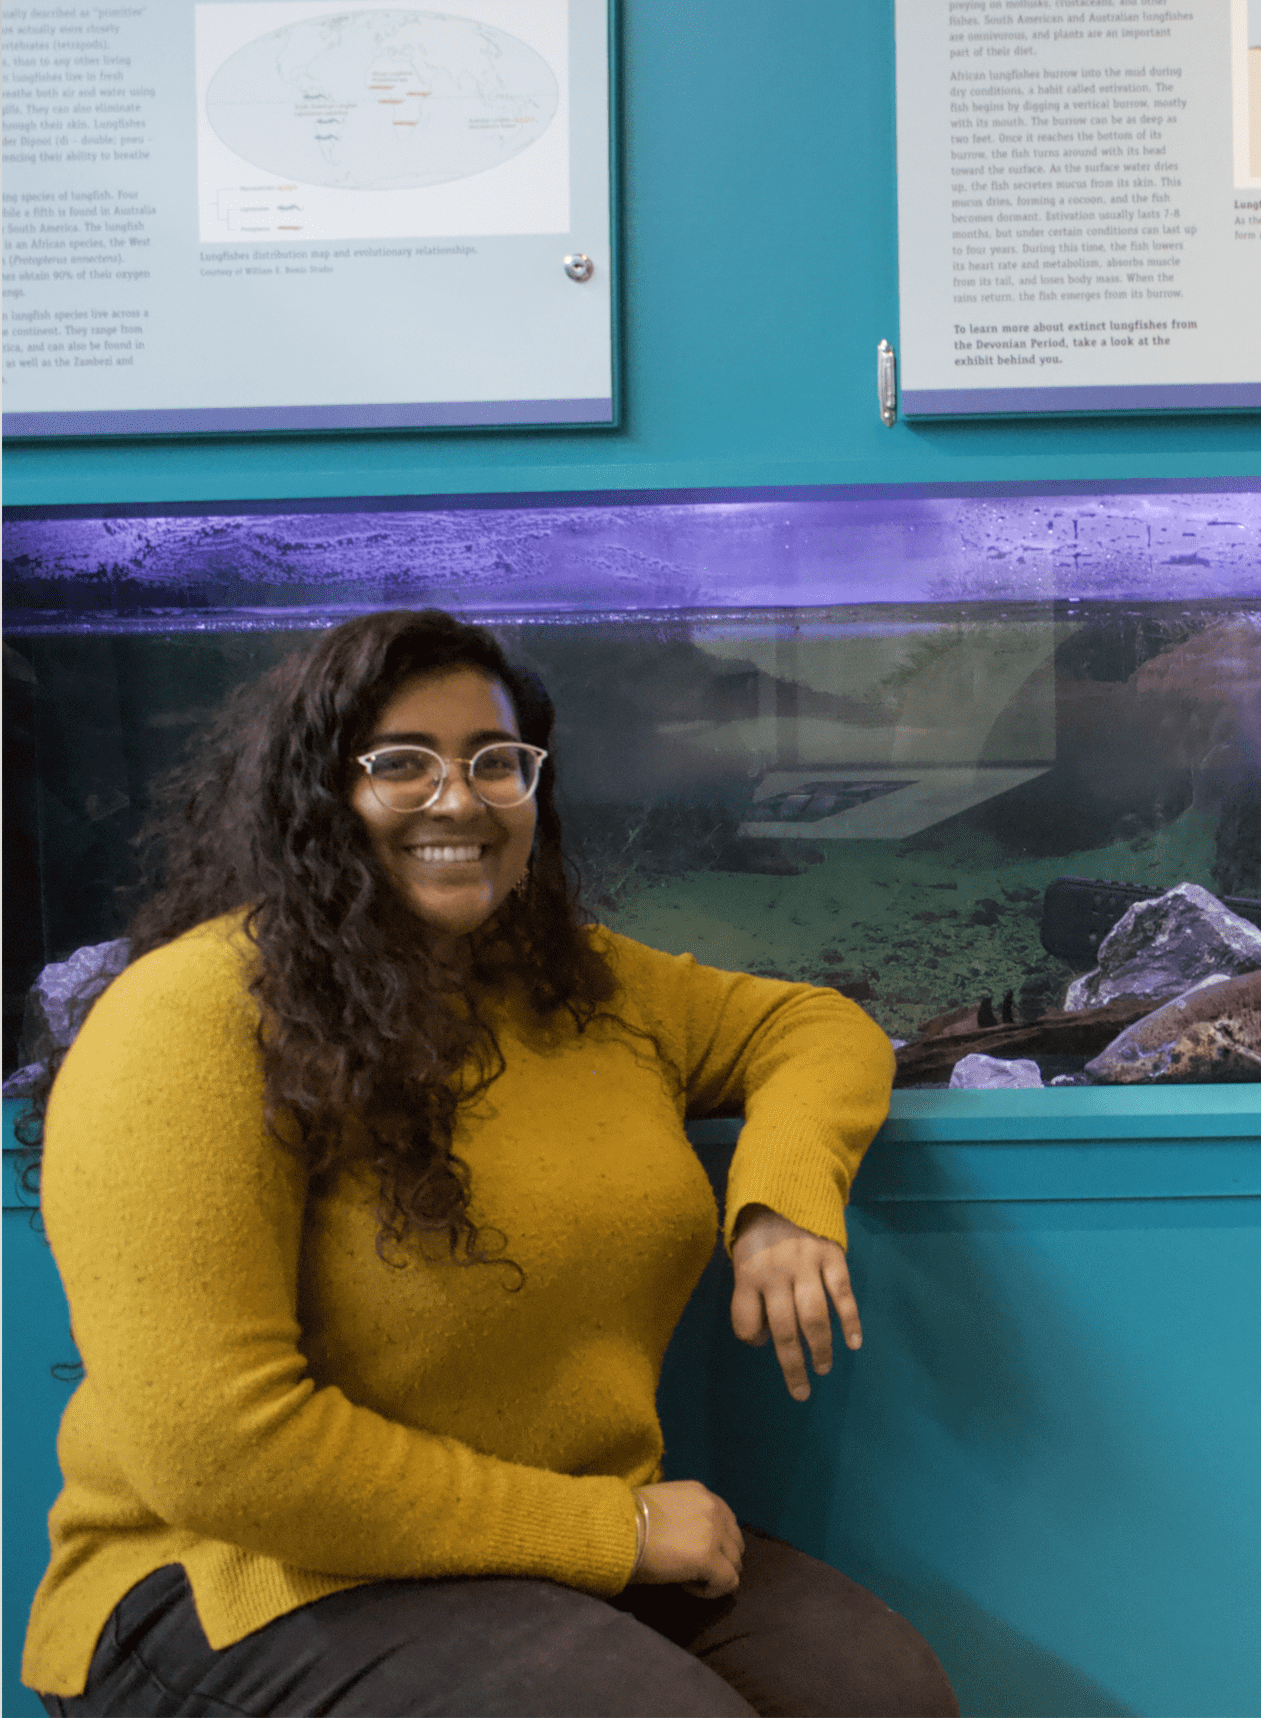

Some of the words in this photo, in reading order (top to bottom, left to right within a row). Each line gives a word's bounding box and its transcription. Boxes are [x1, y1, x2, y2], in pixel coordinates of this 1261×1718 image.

[950, 70, 985, 82] African
[989, 69, 1040, 84] lungfishes
[1043, 68, 1077, 80] burrow
[1081, 68, 1101, 79] into
[1105, 67, 1120, 79] the
[1125, 67, 1146, 78] mud
[1149, 66, 1182, 81] during
[950, 101, 968, 113] fish
[972, 101, 1004, 115] begins
[1007, 100, 1019, 115] by
[1023, 100, 1060, 114] digging
[1064, 102, 1069, 111] a
[1073, 99, 1110, 111] vertical
[1154, 98, 1187, 112] mostly
[950, 117, 972, 128] with
[976, 116, 988, 128] its
[1031, 116, 1048, 127] The
[1052, 115, 1086, 126] burrow
[1090, 117, 1108, 126] can
[1111, 114, 1122, 125] be
[1126, 117, 1136, 125] as
[1140, 114, 1163, 128] deep
[1167, 116, 1177, 124] as
[950, 133, 969, 144] two
[998, 132, 1022, 143] Once
[1026, 132, 1033, 143] it
[1037, 131, 1074, 143] reaches
[1077, 131, 1094, 142] the
[1097, 130, 1133, 142] bottom
[1136, 130, 1146, 141] of
[1149, 130, 1162, 141] its
[991, 148, 1007, 159] the
[1011, 147, 1029, 159] fish
[1033, 147, 1059, 158] turns
[1063, 146, 1098, 158] around
[1101, 146, 1124, 157] with
[1126, 146, 1139, 157] its
[1142, 145, 1166, 157] head
[951, 164, 984, 176] toward
[988, 164, 1004, 175] the
[1050, 162, 1061, 174] As
[1064, 162, 1081, 174] the
[1085, 161, 1120, 173] surface
[1123, 161, 1150, 172] water
[1154, 160, 1178, 172] dries
[1234, 228, 1256, 240] form
[954, 324, 966, 335] To
[969, 323, 998, 334] learn
[1002, 325, 1029, 334] more
[1033, 322, 1064, 333] about
[1068, 321, 1106, 332] extinct
[1110, 319, 1167, 334] lungfishes
[1171, 319, 1198, 330] from
[954, 339, 972, 350] the
[976, 338, 1026, 350] Devonian
[1030, 337, 1069, 350] Period,
[1073, 337, 1096, 348] take
[1101, 339, 1107, 348] a
[1110, 336, 1134, 347] look
[1138, 336, 1148, 347] at
[1152, 335, 1170, 347] the
[954, 354, 993, 366] exhibit
[997, 354, 1036, 365] behind
[1040, 356, 1062, 368] you.
